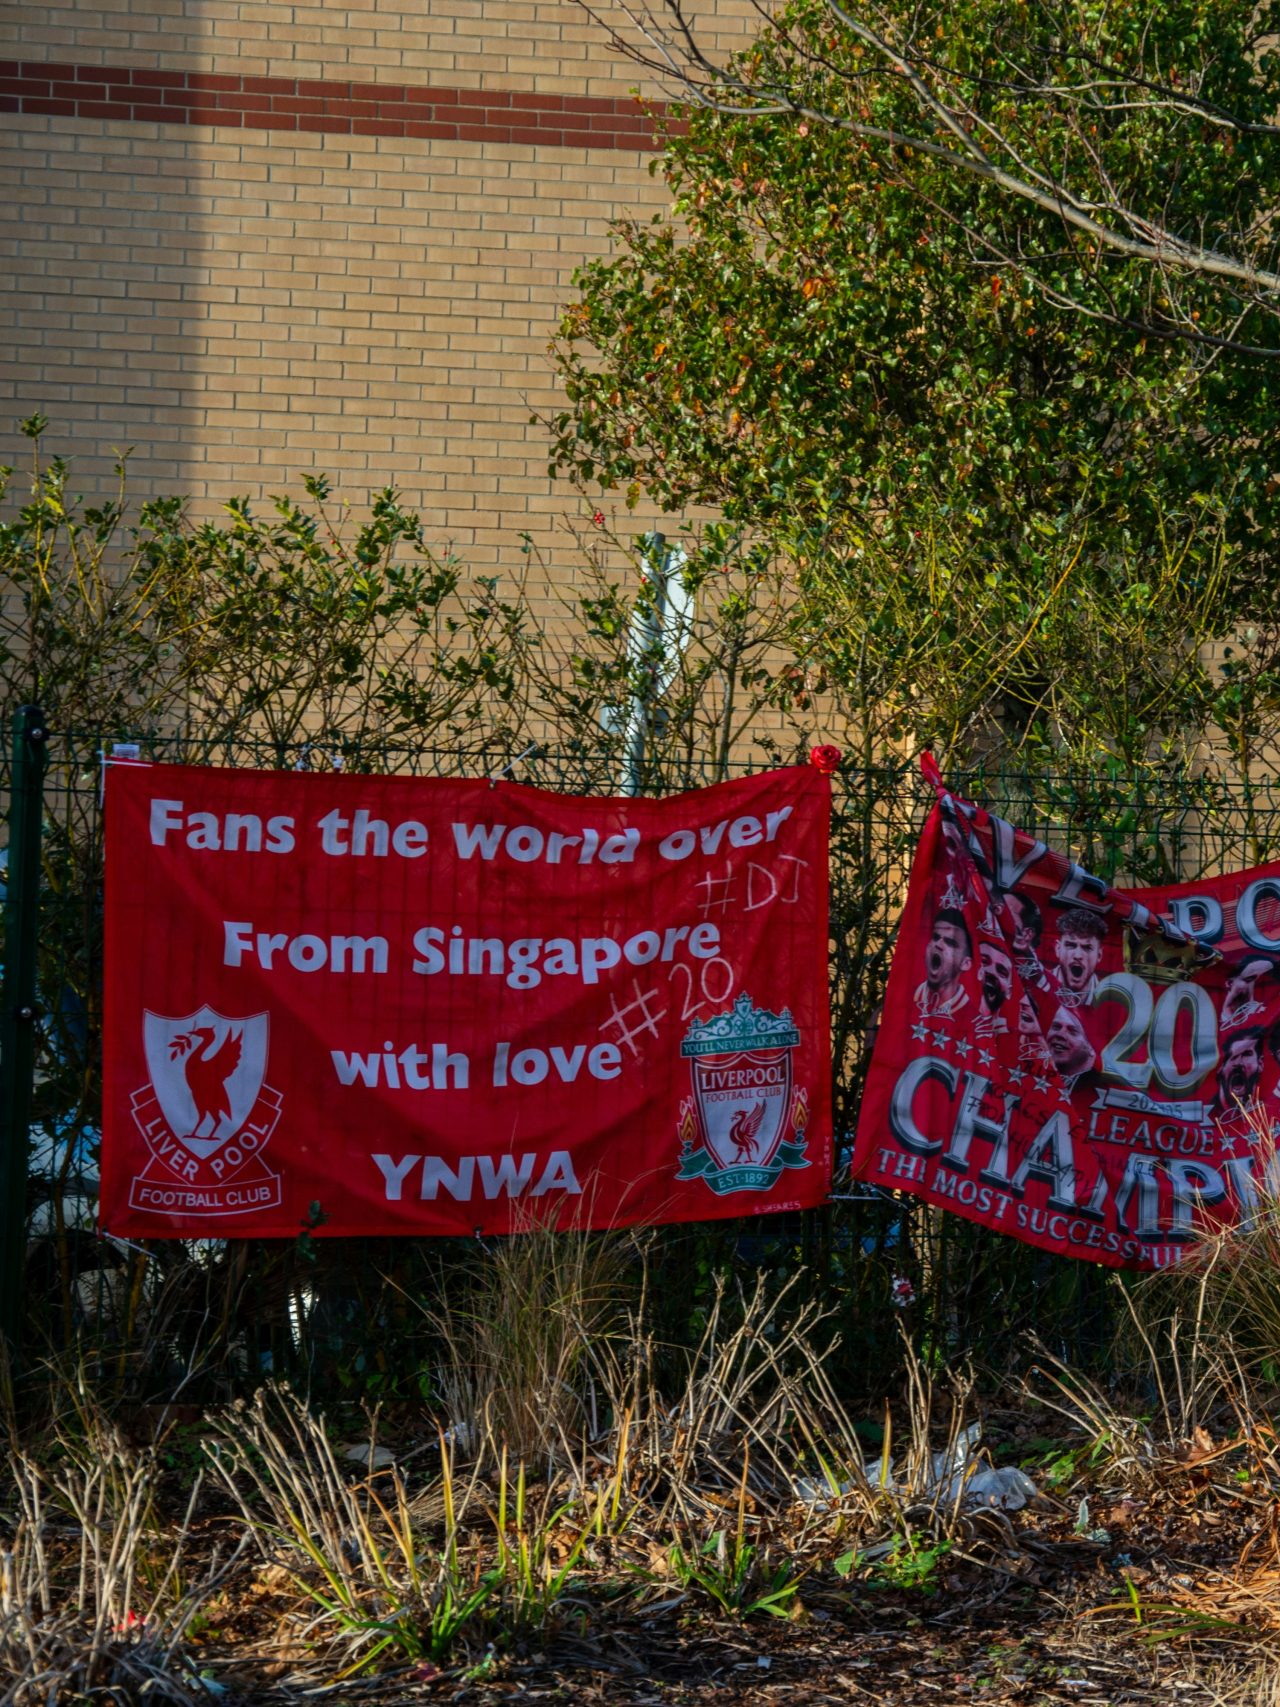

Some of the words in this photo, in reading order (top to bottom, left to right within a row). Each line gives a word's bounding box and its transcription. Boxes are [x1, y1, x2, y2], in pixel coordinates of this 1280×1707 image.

[150, 798, 296, 854] Fans
[317, 808, 429, 858] the
[451, 822, 641, 865] world
[658, 805, 794, 861] over
[222, 920, 390, 974] From
[412, 920, 721, 990] Singapore
[598, 956, 734, 1058] #20
[716, 1037, 745, 1052] NEVER
[746, 1036, 770, 1049] WALK
[770, 1032, 798, 1047] ALONE
[1098, 972, 1219, 1096] 20
[329, 1040, 471, 1090] with
[492, 1041, 623, 1088] love
[701, 1065, 785, 1091] LIVERPOOL
[705, 1090, 754, 1104] FOOTBALL
[756, 1085, 782, 1099] CLUB
[1089, 1114, 1216, 1157] LEAGUE
[138, 1188, 224, 1208] FOOTBALL
[225, 1186, 272, 1206] CLUB
[370, 1150, 583, 1201] YNWA
[931, 1167, 1012, 1219] MOST
